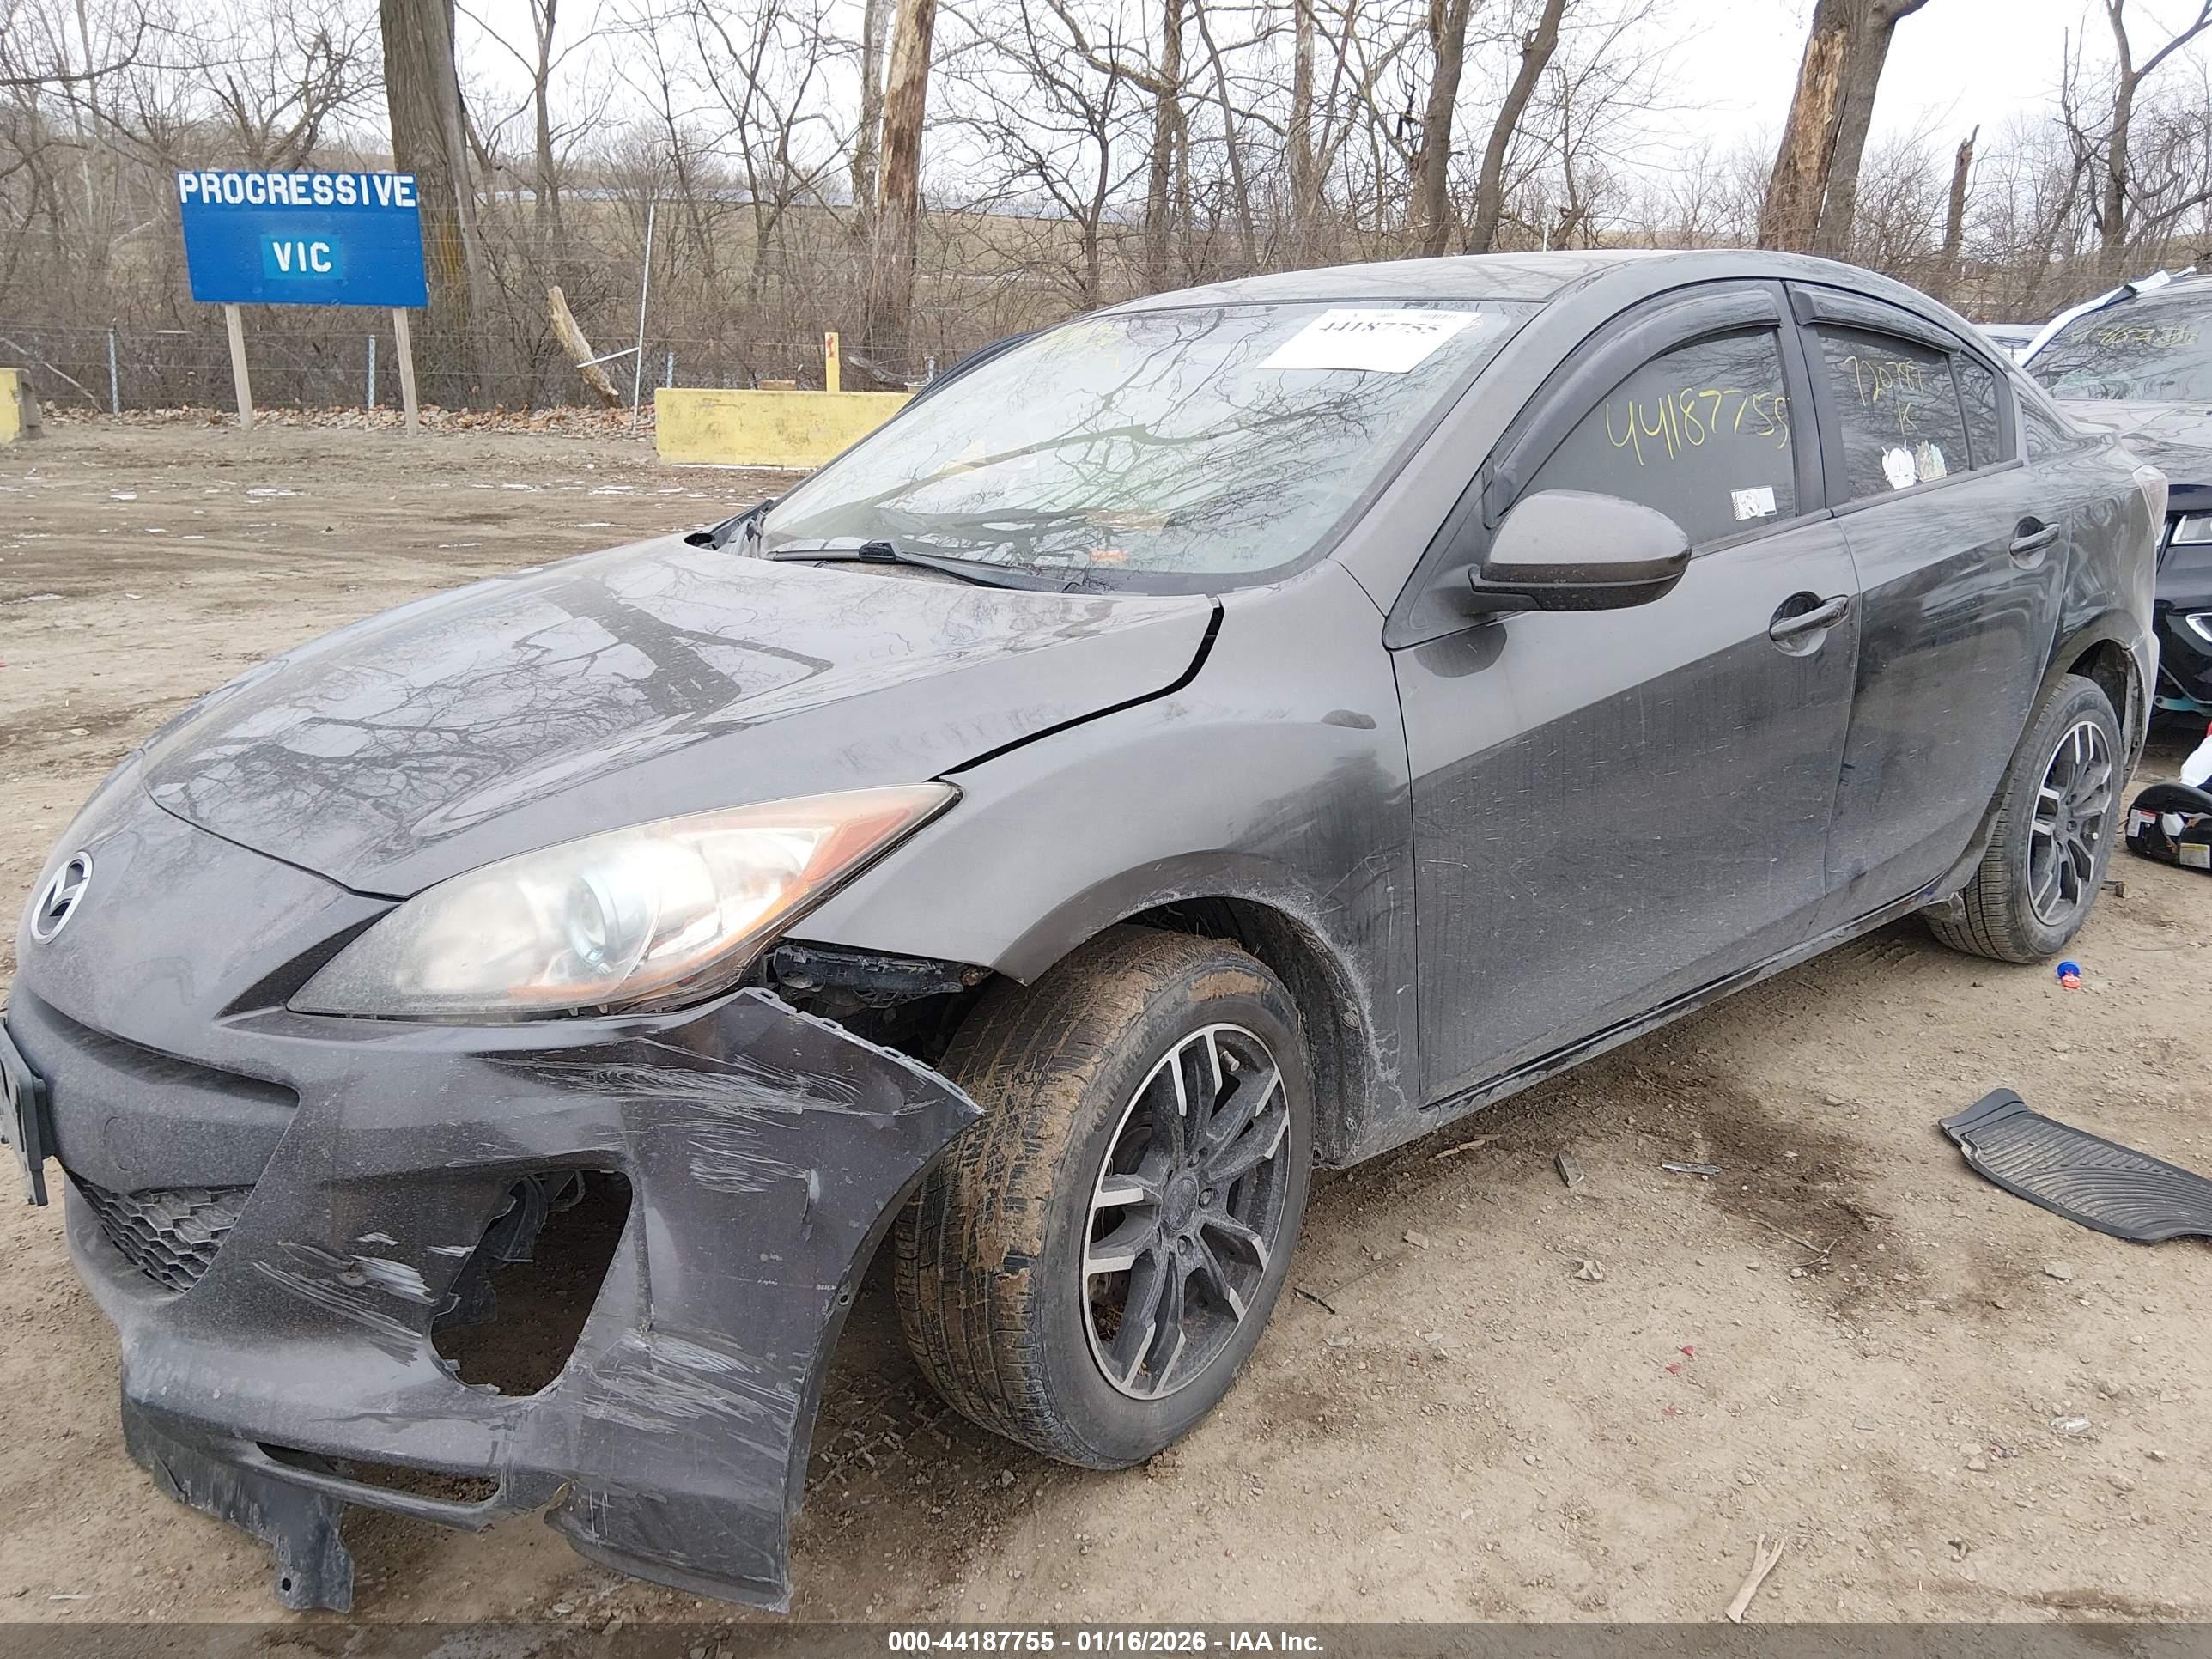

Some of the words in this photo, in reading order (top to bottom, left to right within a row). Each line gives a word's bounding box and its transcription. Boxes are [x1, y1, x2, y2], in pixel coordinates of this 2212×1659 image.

[178, 173, 416, 207] PROGRESSIVE
[272, 241, 332, 273] VIC
[1606, 386, 1790, 466] 44187755
